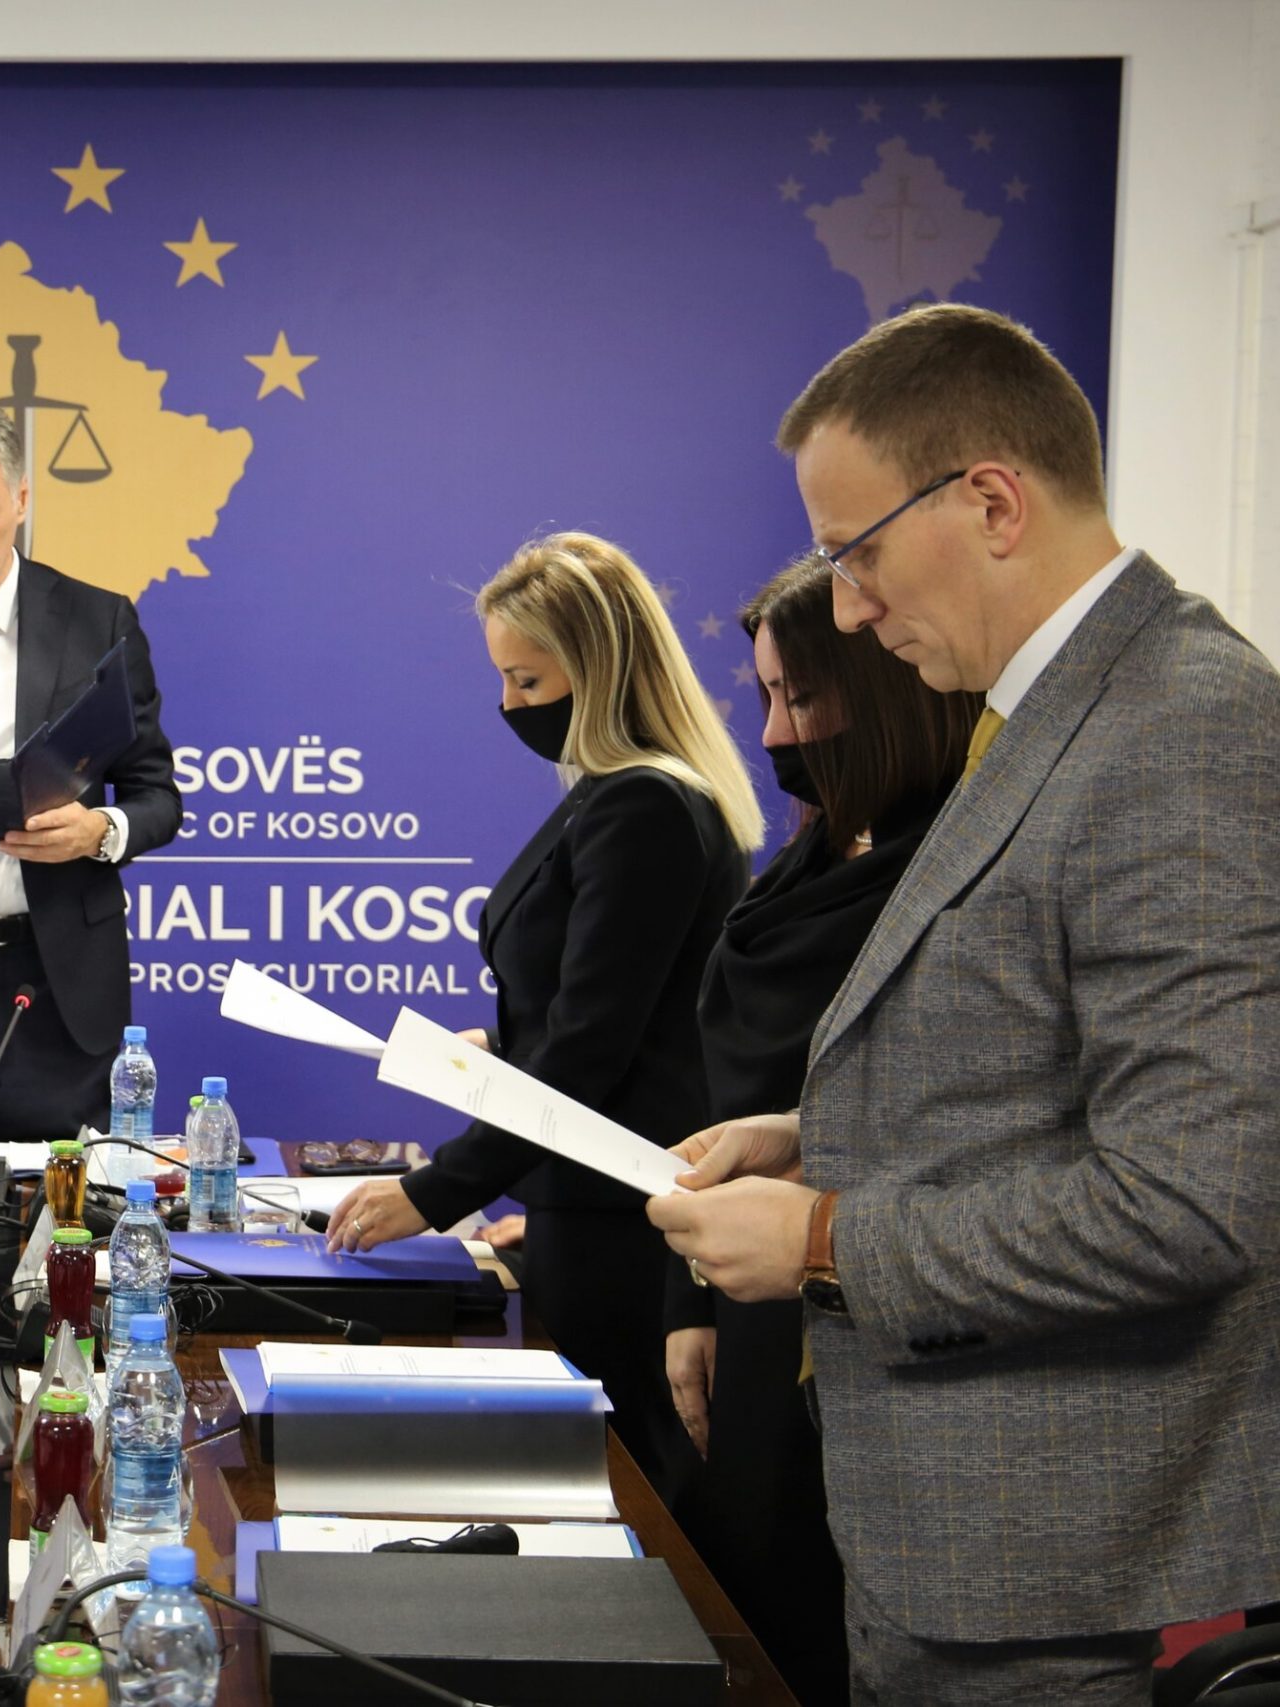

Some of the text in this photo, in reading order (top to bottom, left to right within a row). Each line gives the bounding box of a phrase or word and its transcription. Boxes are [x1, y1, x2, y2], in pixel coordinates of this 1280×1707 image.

[172, 735, 364, 795] SOVËS
[208, 811, 257, 839] OF
[267, 811, 420, 841] KOSOVO
[123, 884, 251, 941] IAL
[269, 885, 284, 941] I
[129, 962, 469, 995] PROSUTORIAL
